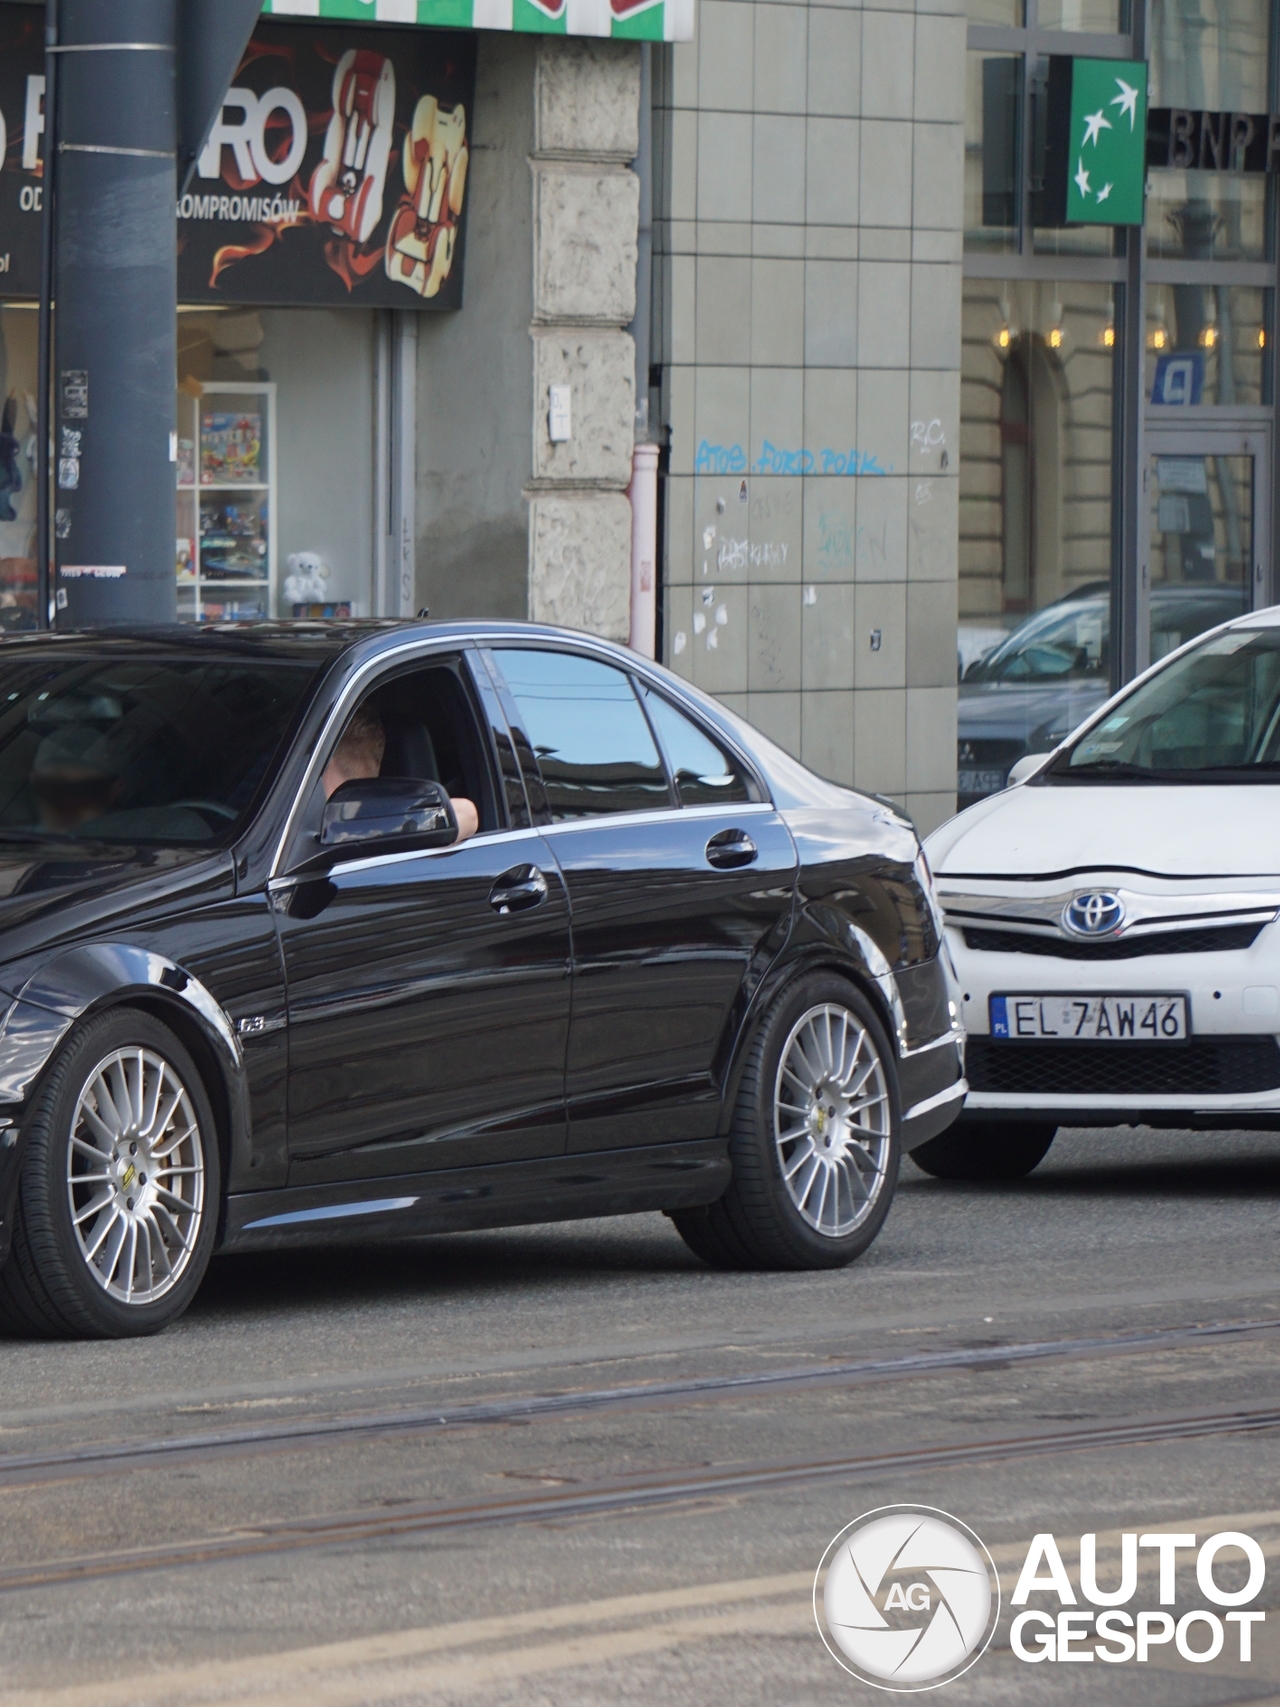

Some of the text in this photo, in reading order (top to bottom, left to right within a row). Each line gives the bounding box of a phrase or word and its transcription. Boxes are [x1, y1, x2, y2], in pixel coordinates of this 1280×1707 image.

[1167, 108, 1254, 170] BNP
[176, 192, 300, 223] OMPROMISÓW
[995, 1001, 1179, 1037] PL EL 7AW46
